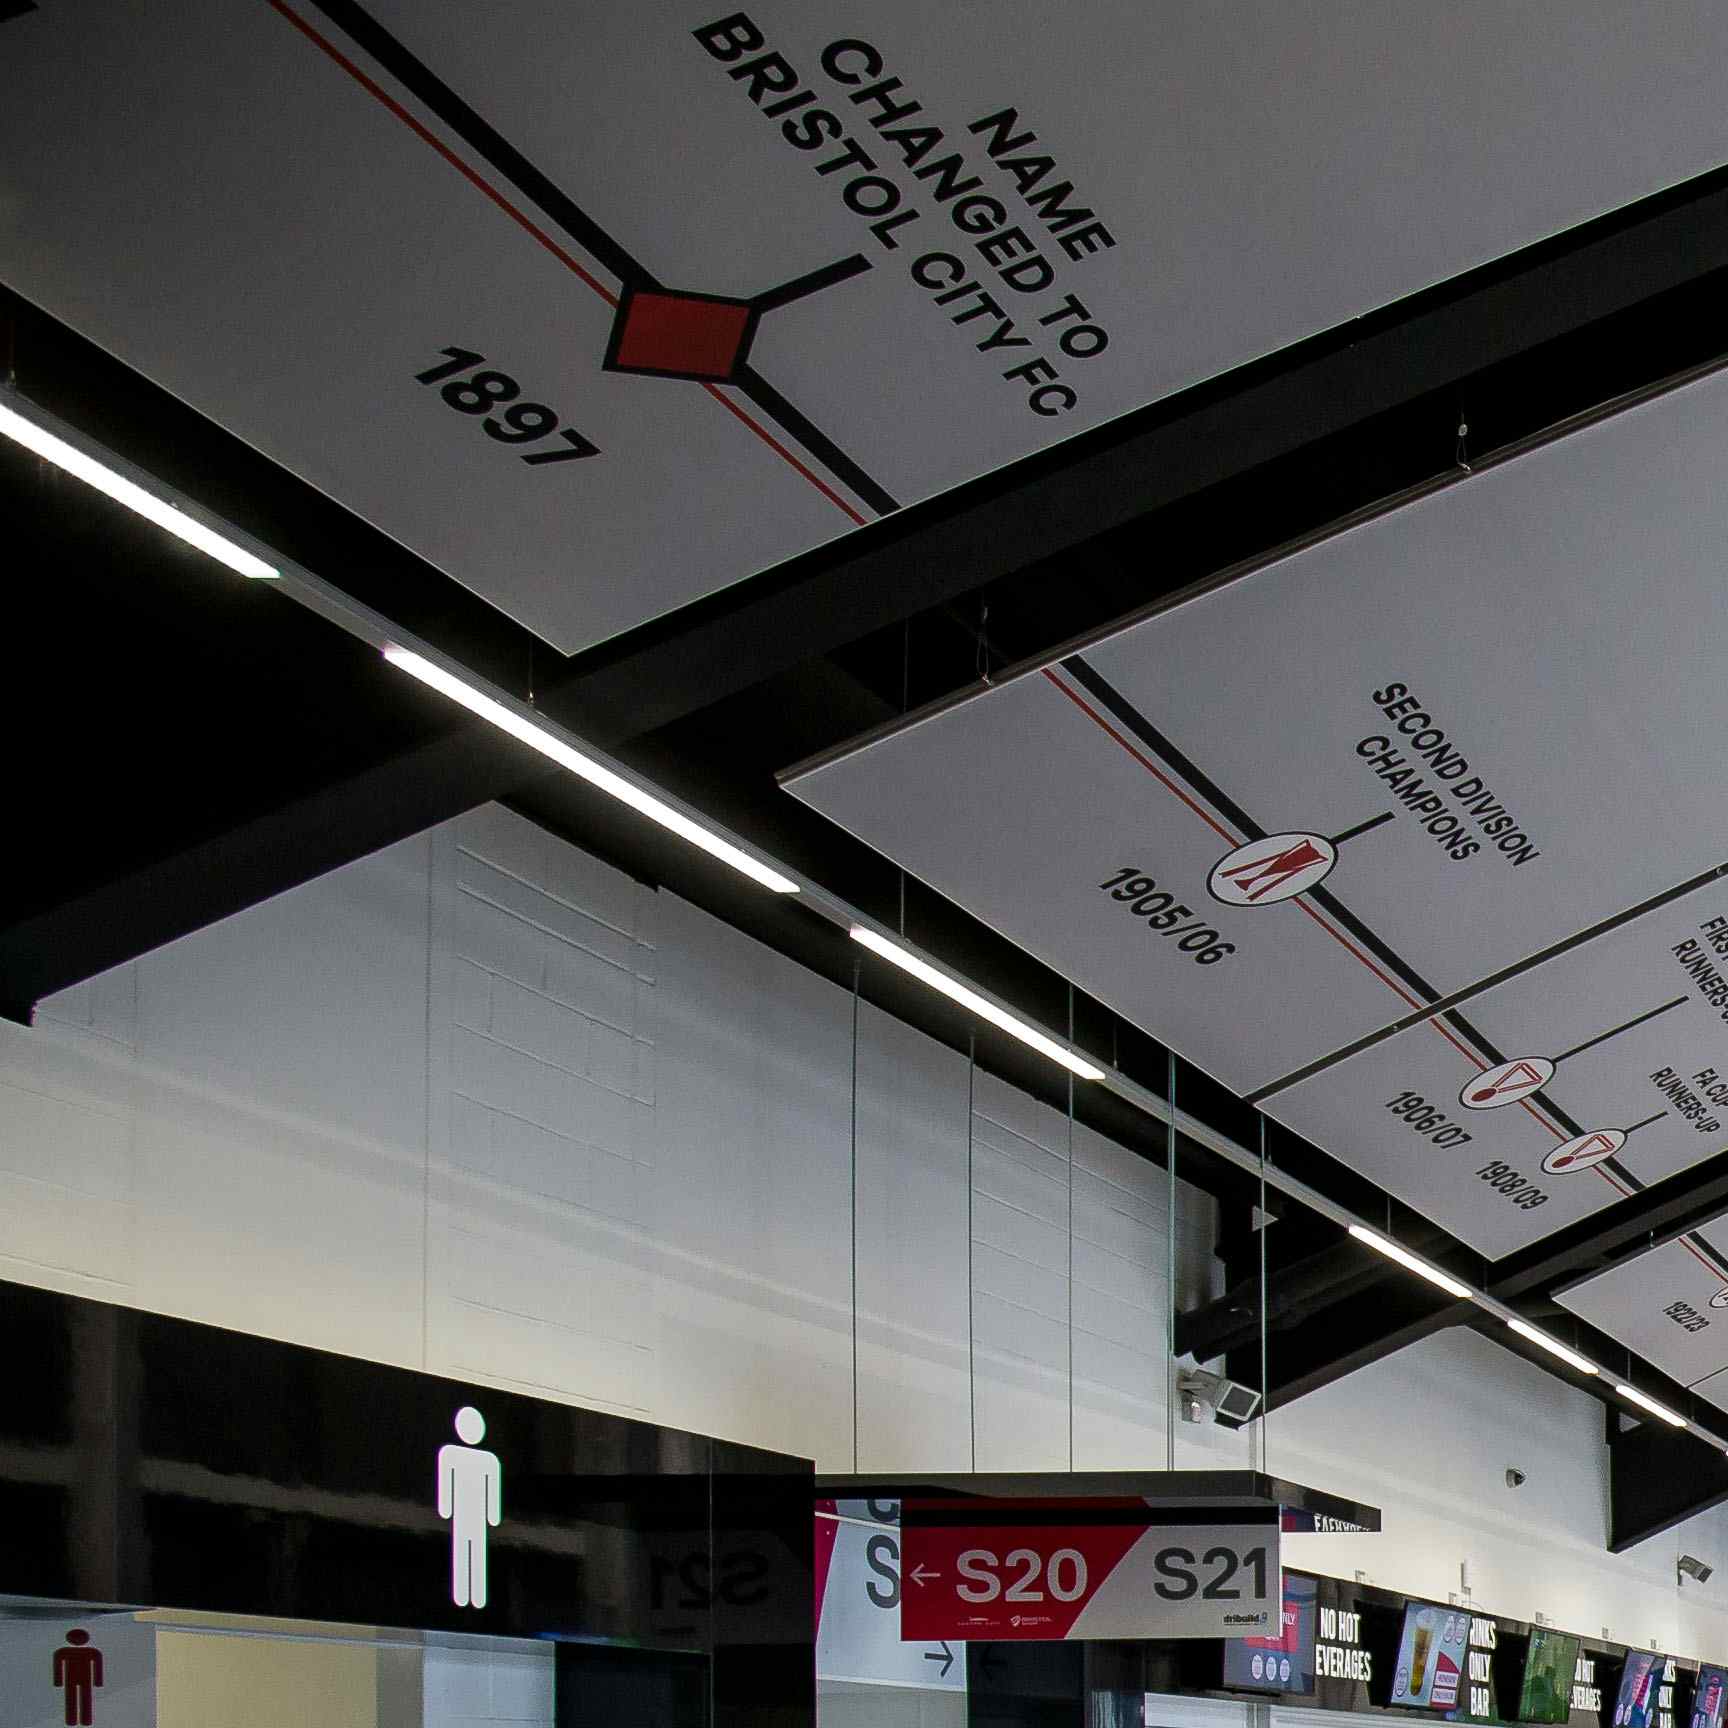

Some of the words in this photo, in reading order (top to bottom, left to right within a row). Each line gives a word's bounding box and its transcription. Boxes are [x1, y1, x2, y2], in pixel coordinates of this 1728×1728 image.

[691, 11, 920, 250] BRISTOL
[910, 252, 1031, 354] CITY
[1003, 356, 1077, 416] FC
[819, 38, 1055, 293] CHANGED
[1042, 293, 1109, 359] TO
[967, 107, 1116, 262] NAME
[414, 346, 602, 466] 1897
[1356, 735, 1480, 862] CHAMPIONS
[1372, 682, 1468, 790] SECOND
[1449, 777, 1540, 867] DIVISION
[1098, 867, 1236, 966] 1905/06
[1649, 1066, 1720, 1133] RUNNERS-UP
[1692, 1068, 1714, 1089] FA
[1385, 1091, 1473, 1151] 1906/07
[1475, 1160, 1549, 1209] 1908/09
[956, 1549, 1088, 1602] S20
[1154, 1547, 1267, 1600] S21
[1320, 1607, 1336, 1640] NO
[1338, 1611, 1361, 1644] HOT
[1315, 1643, 1372, 1682] EVERAGES
[1468, 1651, 1491, 1683] ONLY
[1470, 1686, 1490, 1718] BAR
